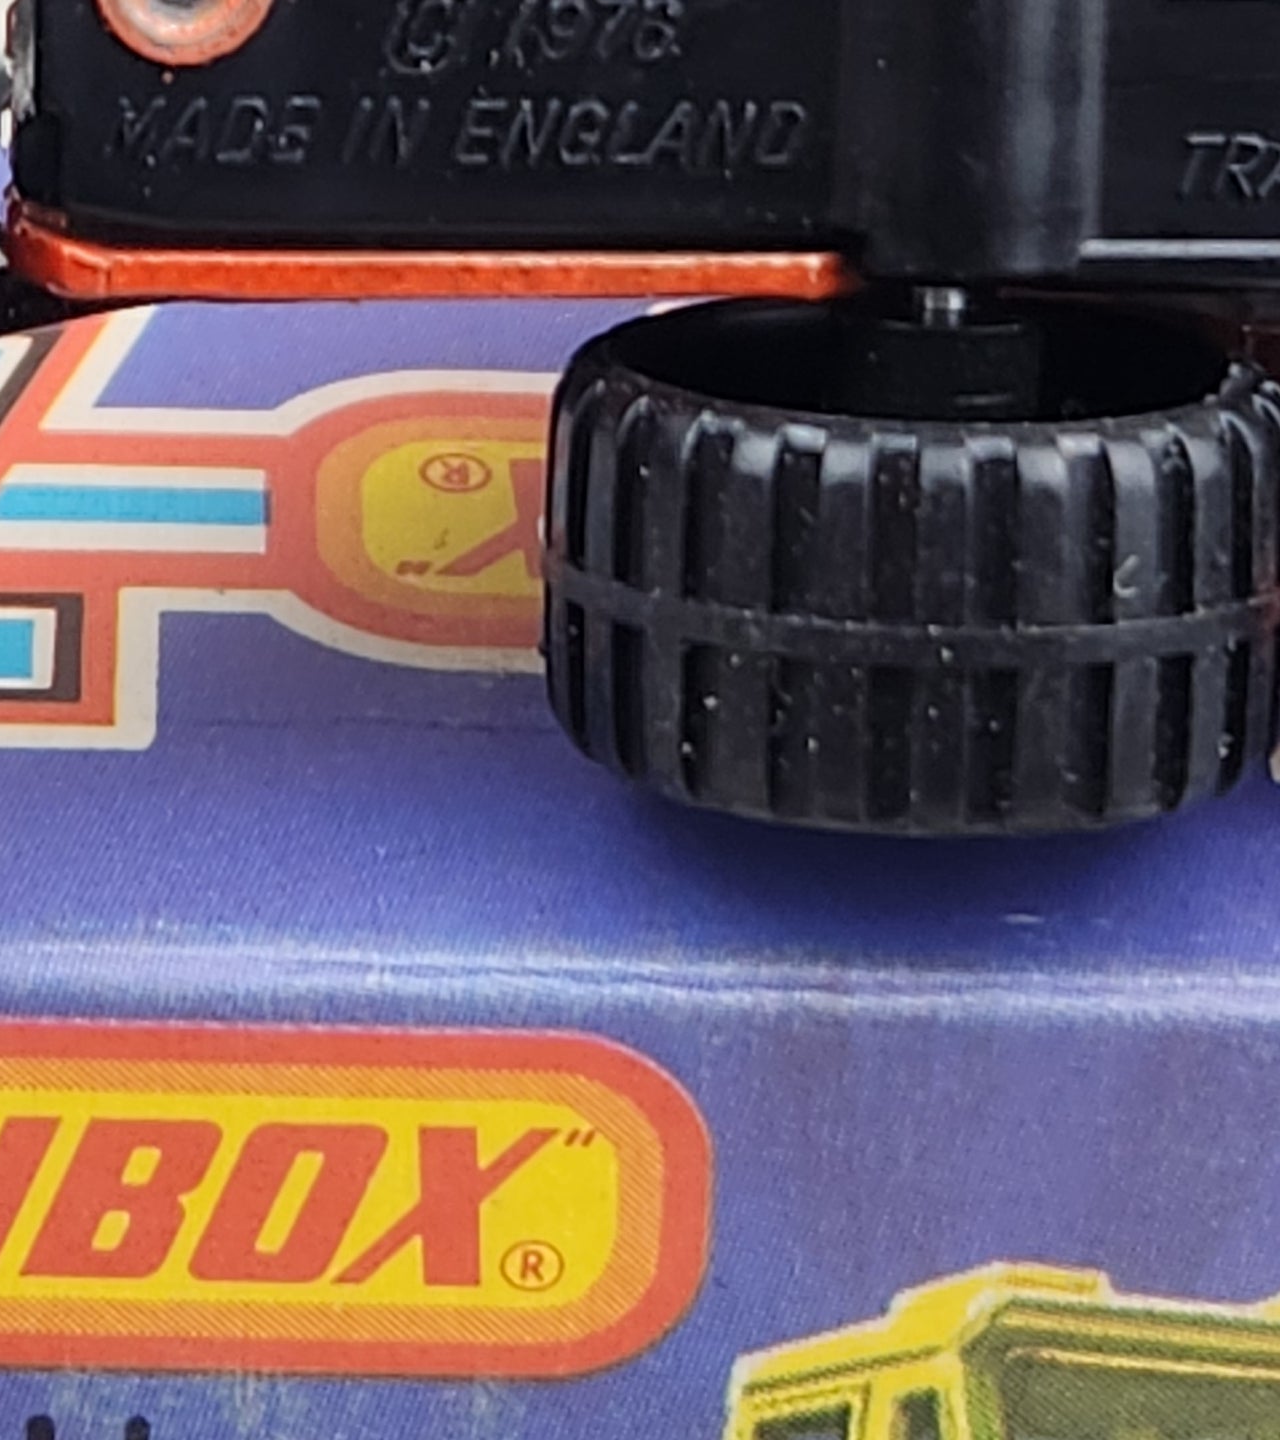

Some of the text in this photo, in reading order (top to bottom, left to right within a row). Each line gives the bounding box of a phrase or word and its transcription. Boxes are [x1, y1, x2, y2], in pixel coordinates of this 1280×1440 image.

[108, 90, 807, 167] MADE IN ENGLAND
